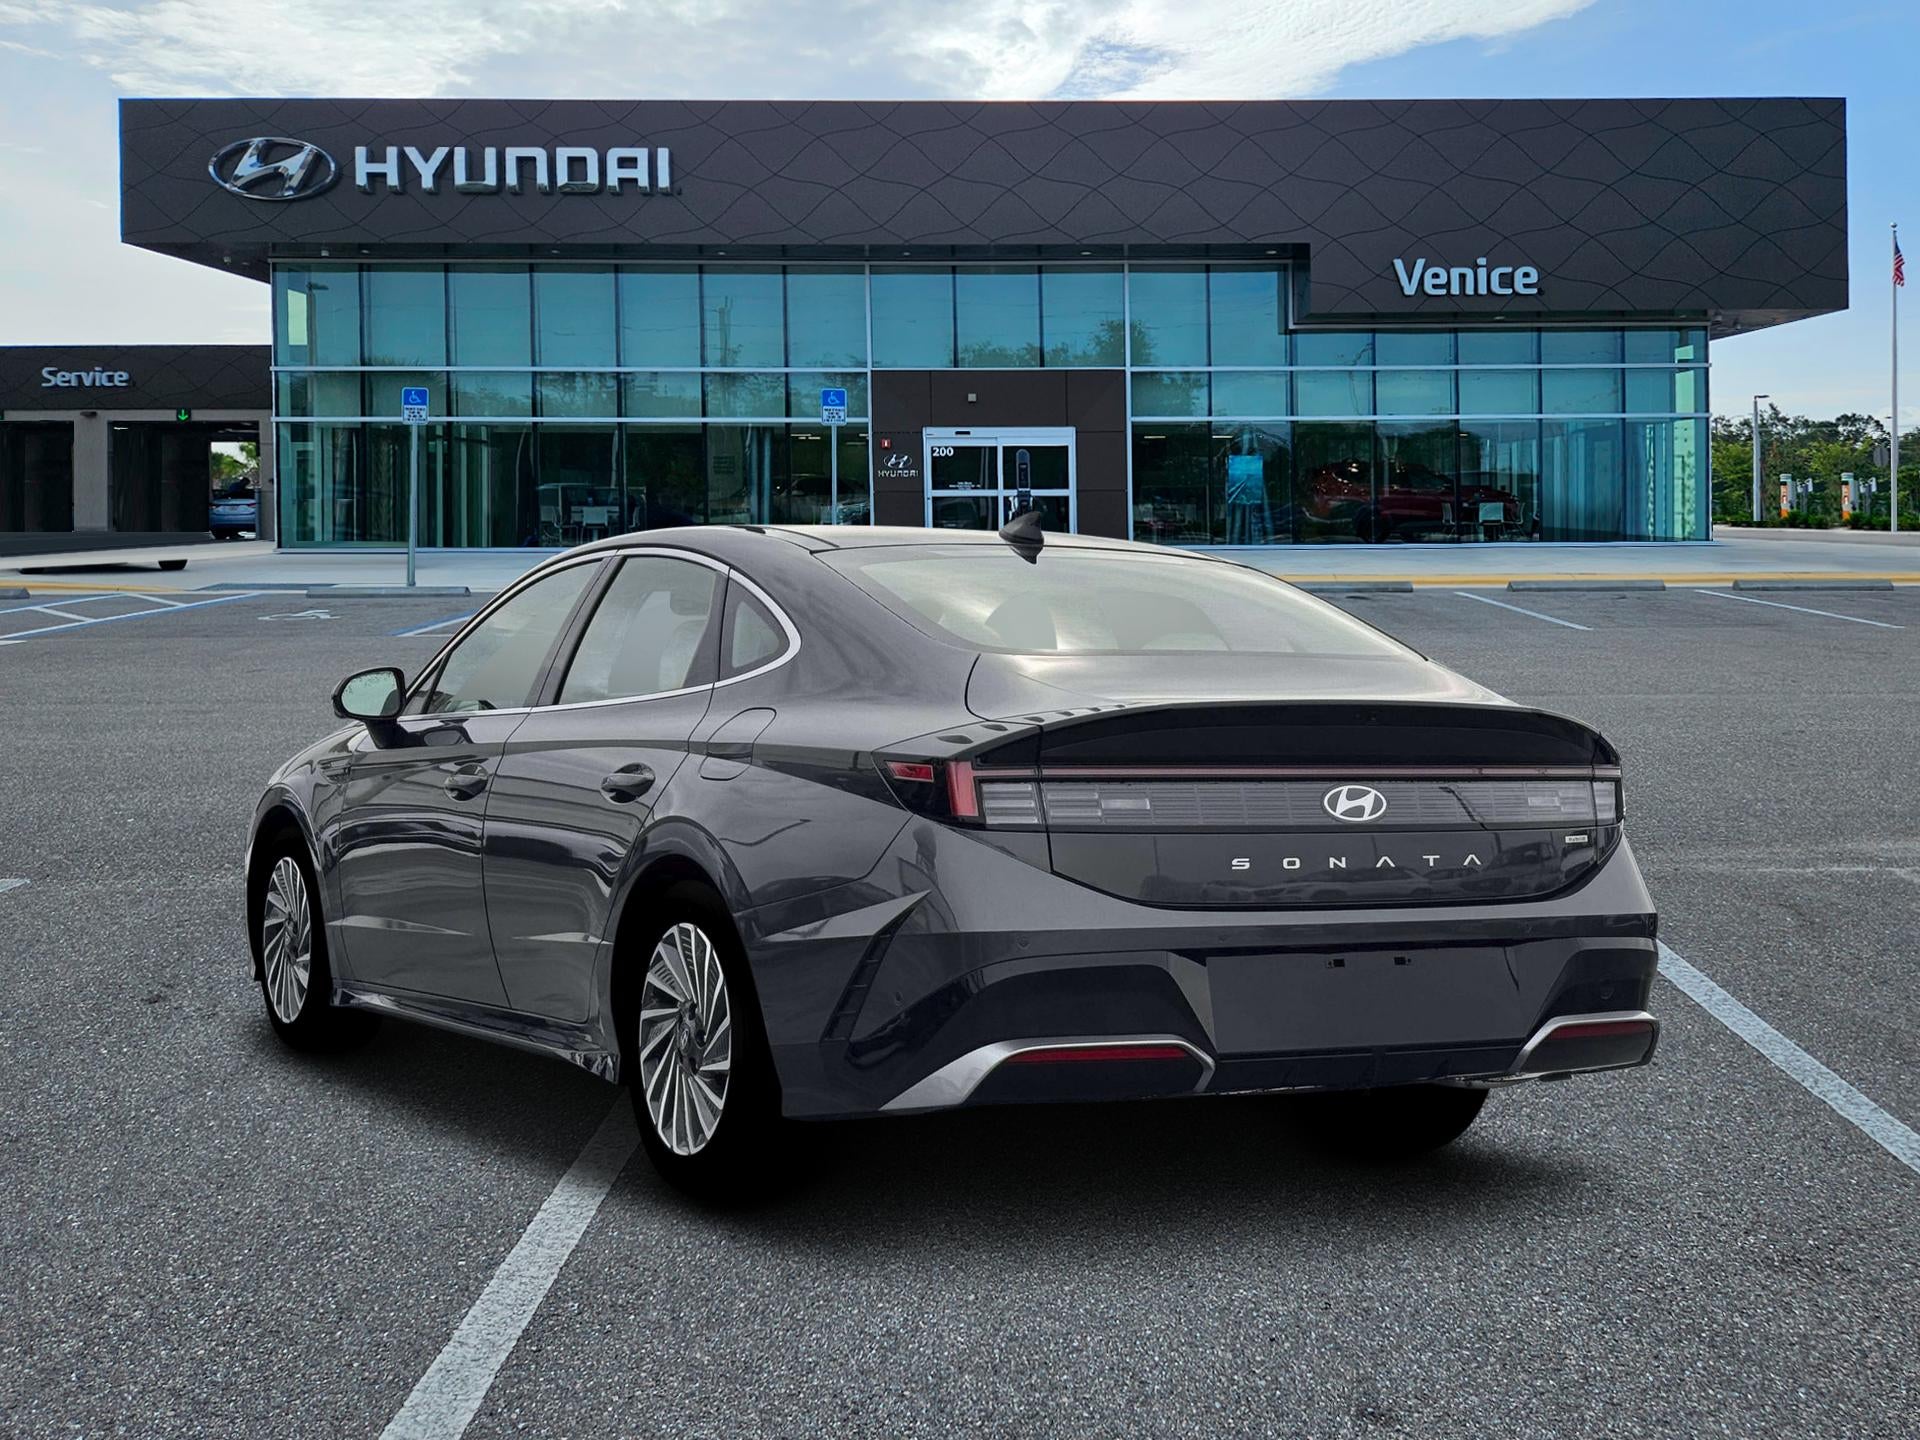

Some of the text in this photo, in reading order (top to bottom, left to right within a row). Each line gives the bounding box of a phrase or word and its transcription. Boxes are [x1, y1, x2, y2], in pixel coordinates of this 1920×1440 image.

[354, 146, 673, 195] HYUNDAI
[1392, 257, 1539, 296] Venice
[41, 366, 130, 387] Service
[932, 446, 954, 457] 200
[878, 469, 919, 478] HYUNDAI
[1231, 854, 1482, 870] SONATA
